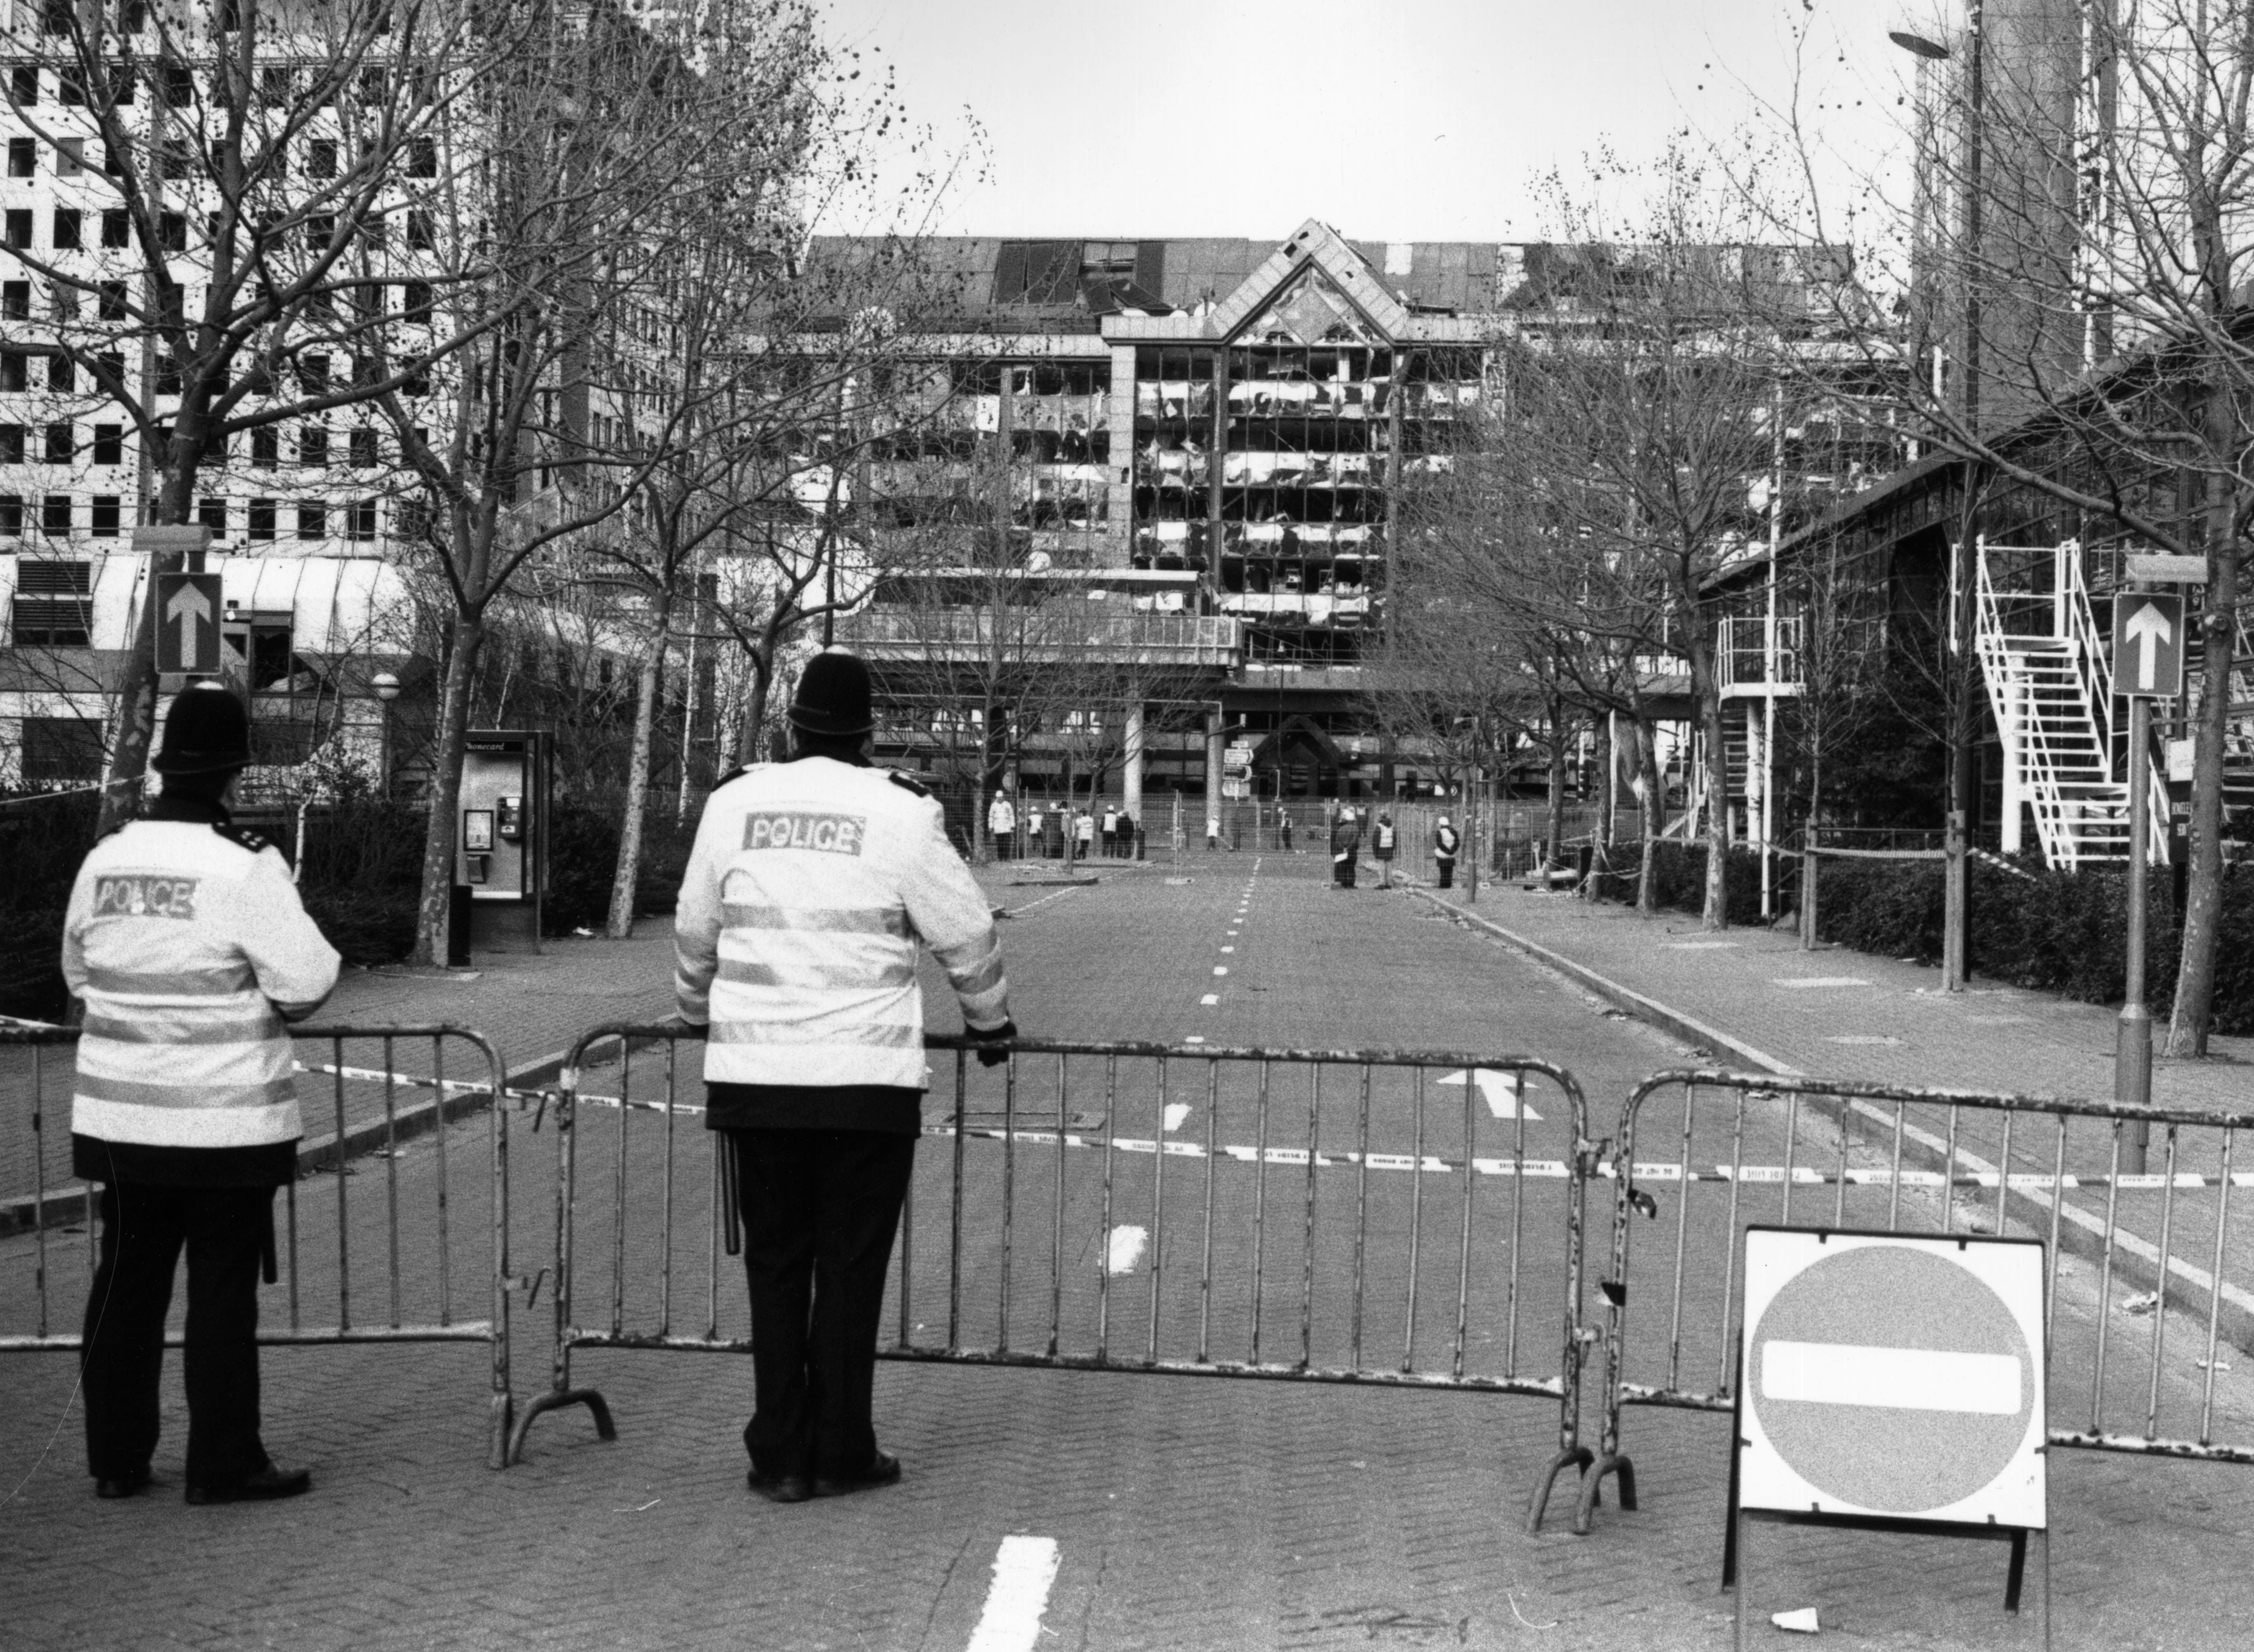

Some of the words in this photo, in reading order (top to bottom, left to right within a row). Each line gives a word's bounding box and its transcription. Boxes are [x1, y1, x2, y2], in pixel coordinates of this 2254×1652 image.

[2171, 802, 2191, 815] HOMELE
[751, 816, 855, 853] POLICE
[96, 879, 192, 914] POLICE
